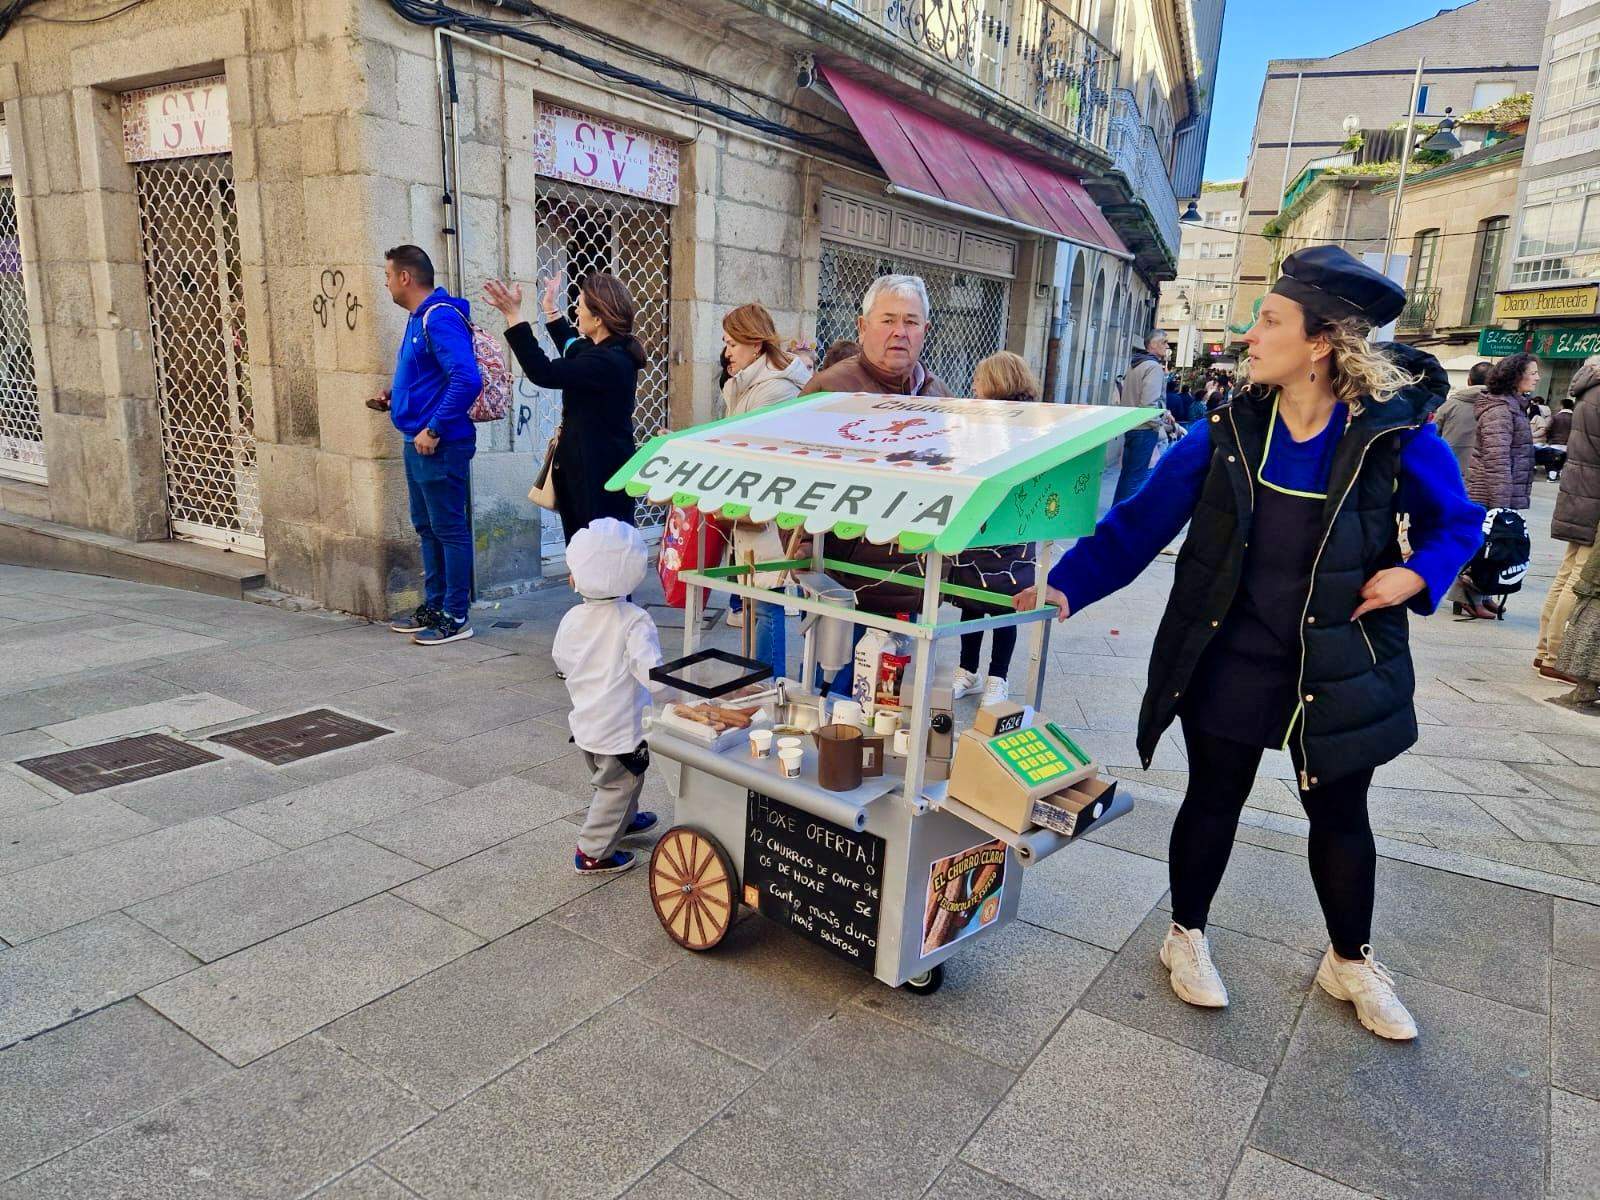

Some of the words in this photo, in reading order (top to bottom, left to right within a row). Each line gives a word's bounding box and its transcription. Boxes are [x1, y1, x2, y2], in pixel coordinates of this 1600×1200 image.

[573, 122, 636, 185] SV
[1536, 290, 1588, 311] Pontevedra
[1557, 333, 1573, 353] EL
[637, 455, 955, 527] CHURRERIA
[749, 827, 764, 844] 12
[766, 838, 814, 869] CHURROS
[817, 863, 829, 877] DE
[832, 872, 861, 892] ONTE
[934, 873, 947, 892] EL
[947, 852, 980, 880] CHURRO
[980, 849, 1005, 865] CLARO
[778, 862, 791, 876] DE
[793, 869, 826, 895] HOXE
[854, 900, 873, 918] 5€
[820, 928, 860, 958] sabroso
[844, 922, 877, 949] duro
